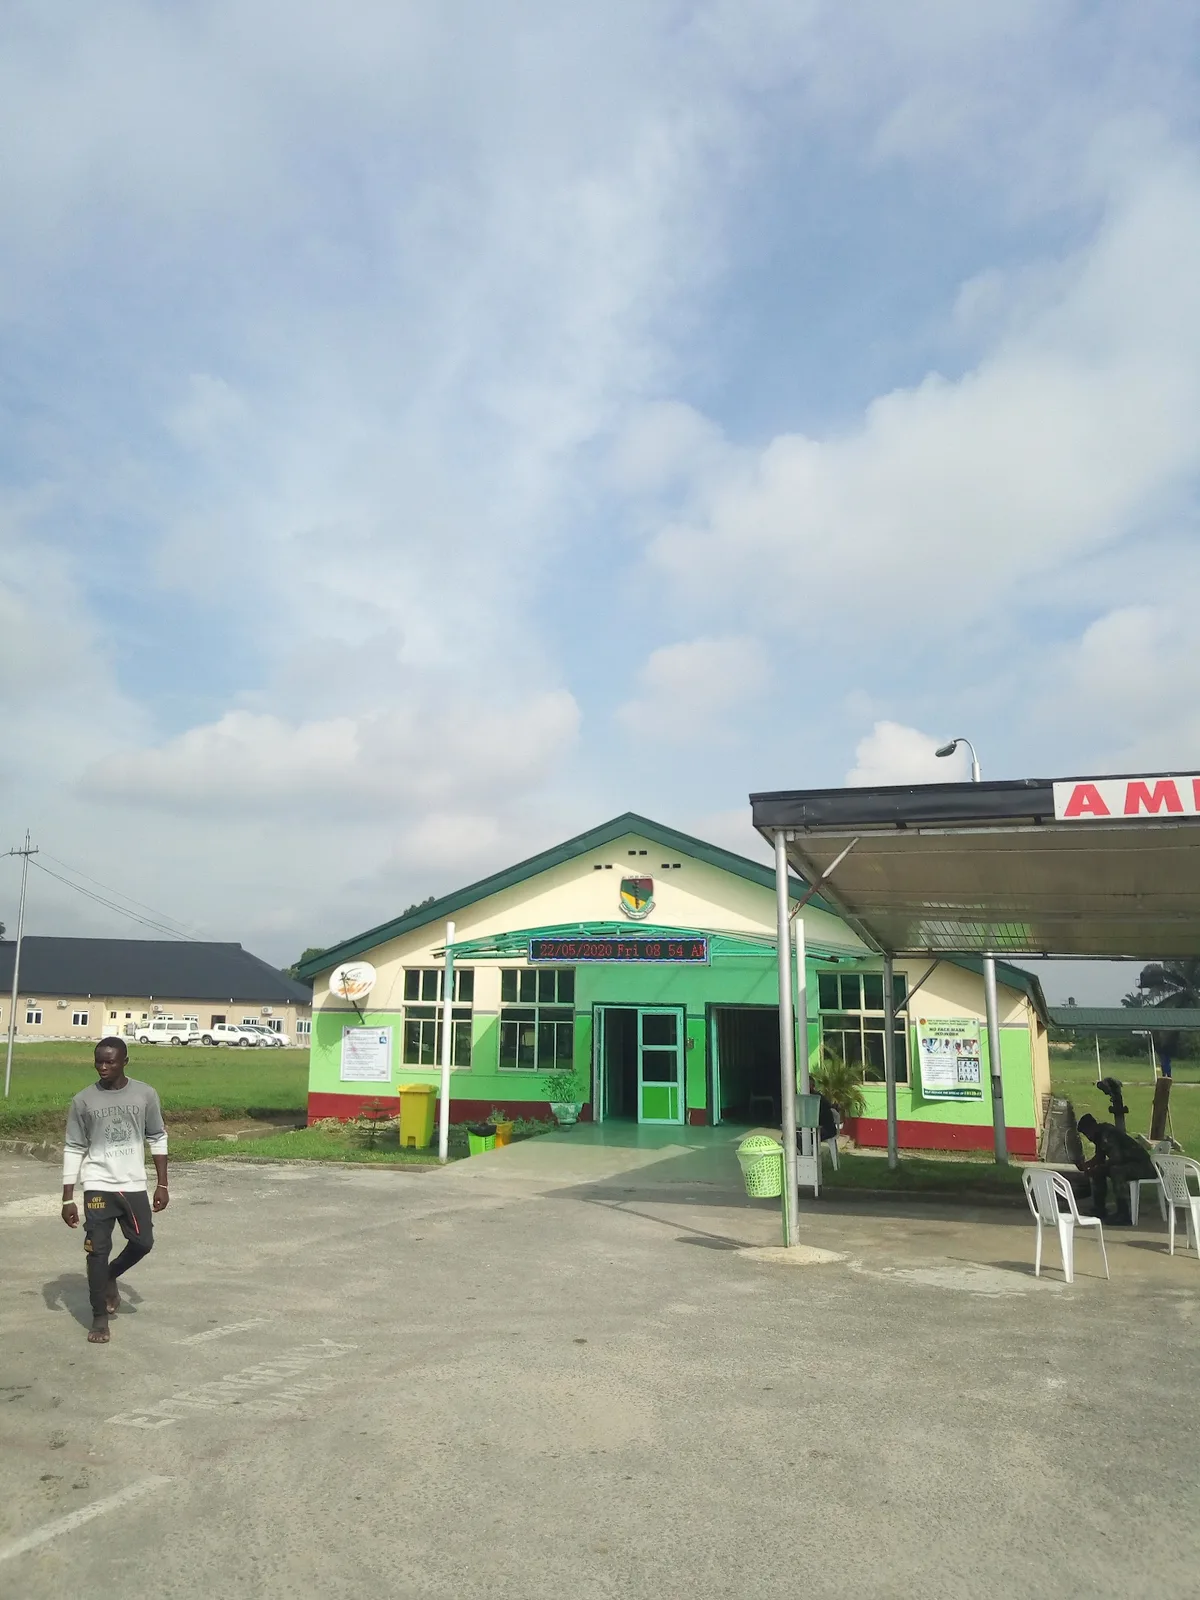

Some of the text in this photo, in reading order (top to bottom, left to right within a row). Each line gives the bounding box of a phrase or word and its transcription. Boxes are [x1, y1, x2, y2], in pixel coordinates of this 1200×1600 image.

[1064, 778, 1200, 817] AM
[540, 943, 613, 957] 22/05/2020
[617, 943, 640, 957] Fri
[645, 943, 661, 957] 08
[668, 944, 684, 957] 54
[93, 1104, 140, 1119] REFINED
[105, 1148, 136, 1158] AVENUE
